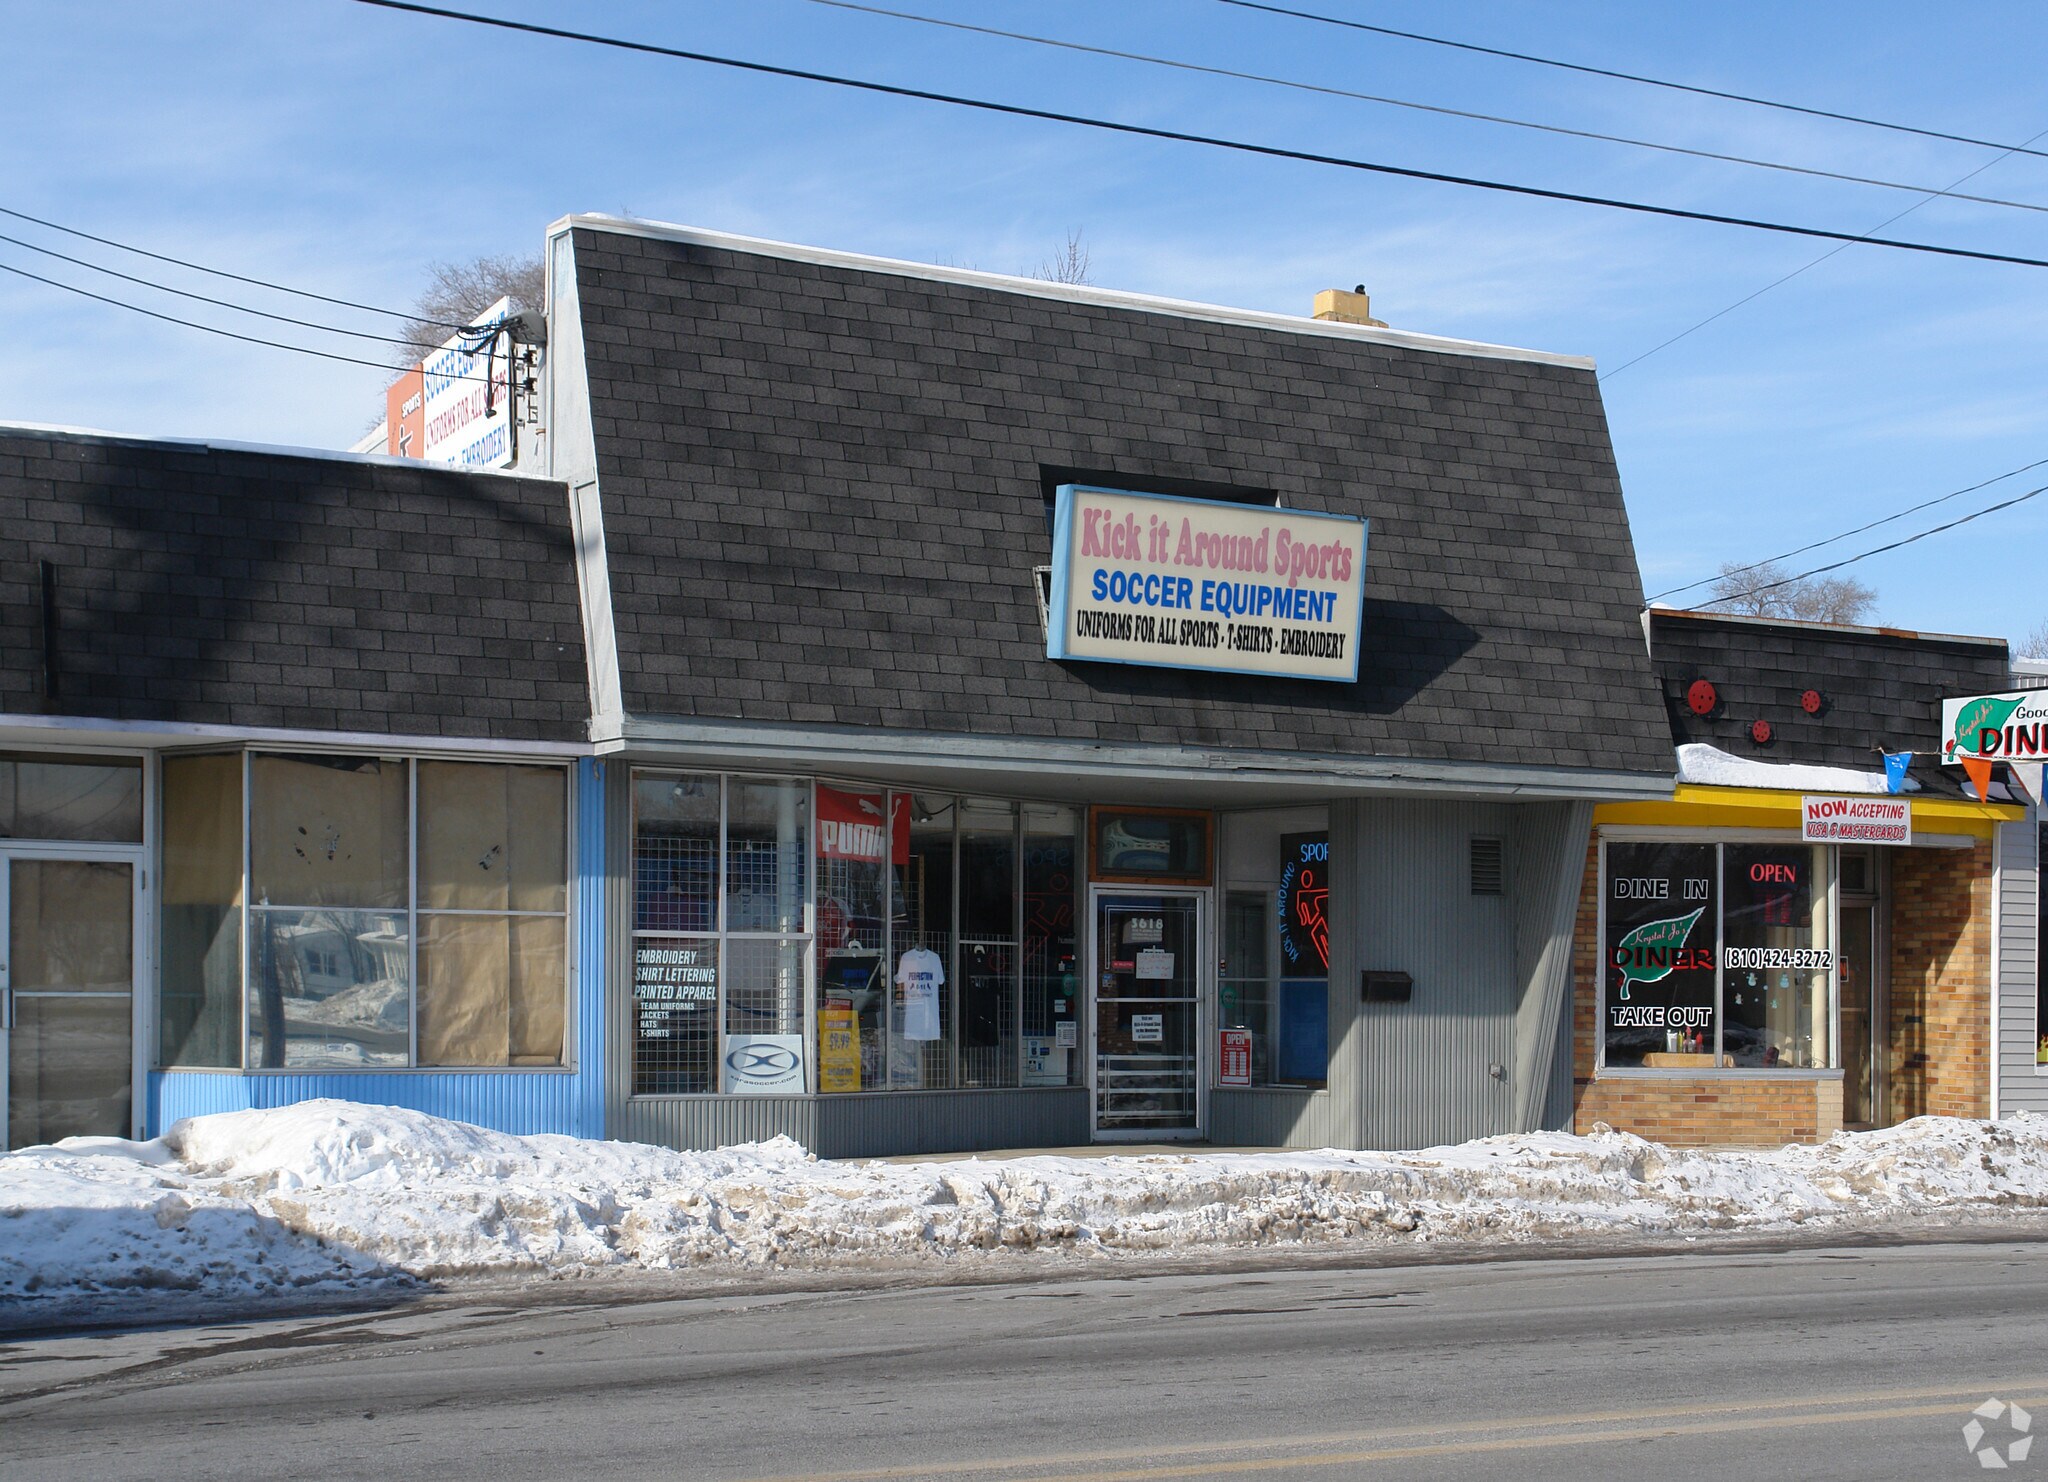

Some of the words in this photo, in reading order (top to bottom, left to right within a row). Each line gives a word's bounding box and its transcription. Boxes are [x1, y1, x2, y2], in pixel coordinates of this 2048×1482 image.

[426, 350, 455, 403] SOCCER
[402, 391, 421, 419] SPORTS
[426, 412, 455, 449] UNIFORMS
[457, 396, 469, 431] FOR
[471, 387, 482, 422] ALL
[484, 368, 507, 412] SRTS
[1081, 507, 1142, 562] Kick
[1148, 513, 1170, 565] it
[1174, 516, 1270, 574] Around
[1275, 527, 1353, 588] Sports
[1092, 568, 1194, 610] SOCCER
[1200, 579, 1338, 623] EQUIPMENT
[1076, 608, 1133, 642] UNIFORMS
[1134, 614, 1155, 644] FOR
[1157, 616, 1178, 646] ALL
[1180, 618, 1220, 649] SPORTS
[1227, 622, 1274, 654] T-SHIRTS
[1280, 627, 1347, 659] EMBROIDERY
[1808, 799, 1848, 820] NOW
[1849, 803, 1905, 820] ACCEPTING
[820, 820, 891, 857] PUMA
[1806, 821, 1829, 838] VISA
[1829, 822, 1838, 837] &
[1838, 823, 1908, 841] MASTERCARDS
[1750, 863, 1797, 883] OPEN
[1278, 861, 1295, 917] AROUND
[1614, 878, 1669, 899] DINE
[1683, 878, 1709, 900] IN
[1630, 924, 1666, 946] Krystal
[1667, 922, 1687, 941] Jo's
[635, 949, 698, 965] EMBROIDERY
[1608, 945, 1716, 970] DINER
[1724, 947, 1833, 970] (810)424-3272
[635, 966, 665, 982] SHIRT
[665, 967, 716, 983] LETTERING
[634, 984, 674, 1000] PRINTED
[675, 985, 717, 1001] APPAREL
[640, 1002, 660, 1010] TEAM
[660, 1002, 695, 1011] UNIFORMS
[640, 1010, 670, 1020] JACKETS
[1611, 1007, 1665, 1027] TAKE
[1667, 1007, 1712, 1027] OUT
[640, 1020, 658, 1029] HATS
[640, 1029, 670, 1038] T-SHIRTS
[1226, 1033, 1246, 1045] OPEN
